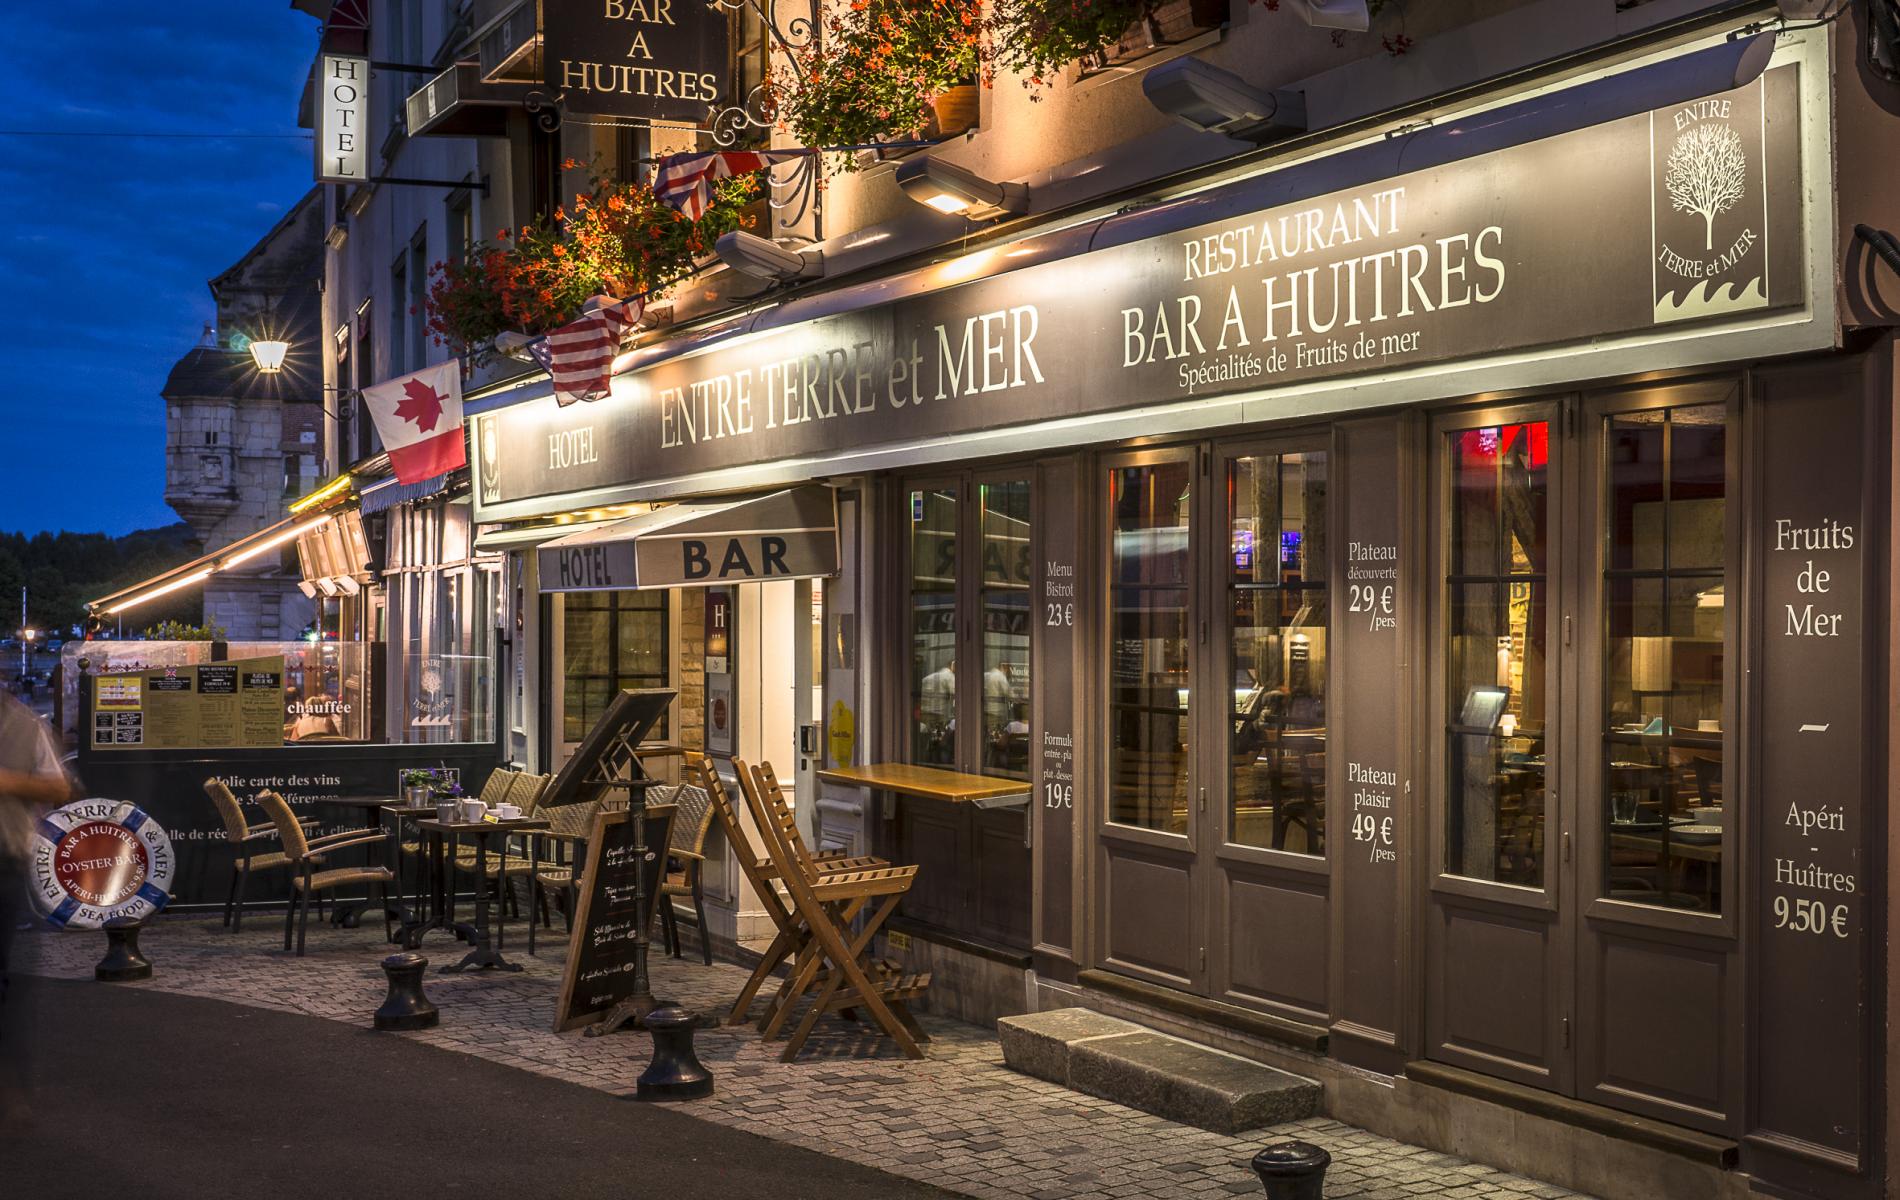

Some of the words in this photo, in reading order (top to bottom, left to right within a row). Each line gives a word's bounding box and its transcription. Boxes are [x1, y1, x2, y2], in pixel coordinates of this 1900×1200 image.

[604, 0, 676, 26] BAR
[627, 31, 653, 60] A
[560, 60, 718, 101] HUITRES
[331, 58, 357, 177] HOTEL
[1673, 100, 1731, 131] ENTRE
[1183, 187, 1405, 282] RESTAURANT
[1657, 244, 1703, 278] TERRE
[1707, 262, 1720, 277] et
[1722, 228, 1757, 272] MER
[1121, 294, 1206, 368] BAR
[1216, 285, 1248, 351] A
[1261, 226, 1506, 342] HUITRES
[659, 369, 753, 449] ENTRE
[759, 341, 877, 430] TERRE
[887, 347, 924, 410] et
[933, 304, 1045, 401] MER
[1179, 352, 1262, 395] Spécialités
[1266, 347, 1288, 374] de
[1295, 338, 1348, 370] Fruits
[1352, 333, 1376, 361] de
[1381, 329, 1421, 357] mer
[549, 427, 598, 470] HOTEL
[1775, 518, 1854, 550] Fruits
[560, 547, 612, 586] HOTEL
[682, 536, 791, 580] BAR
[1348, 542, 1397, 560] Plateau
[1047, 561, 1073, 577] Menu
[1348, 566, 1397, 579] découverte
[1797, 560, 1830, 594] de
[1046, 581, 1074, 597] Bistrot
[714, 604, 725, 628] H
[1784, 604, 1842, 637] Mer
[287, 700, 351, 714] chauffée
[1044, 731, 1072, 747] Formule
[250, 775, 284, 786] carte
[288, 774, 309, 785] des
[314, 774, 341, 785] vins
[1348, 762, 1396, 786] Plateau
[1354, 788, 1391, 811] plaisir
[189, 829, 204, 839] de
[1785, 801, 1845, 836] Apéri
[61, 838, 79, 858] BAR
[80, 831, 88, 839] A
[90, 825, 139, 850] HUITRES
[37, 845, 60, 900] ENTRE
[62, 857, 112, 873] OYSTER
[115, 853, 142, 866] BAR
[153, 845, 168, 879] MER
[1775, 858, 1855, 893] Huîtres
[79, 908, 104, 921] SEA
[109, 899, 144, 919] FOOD
